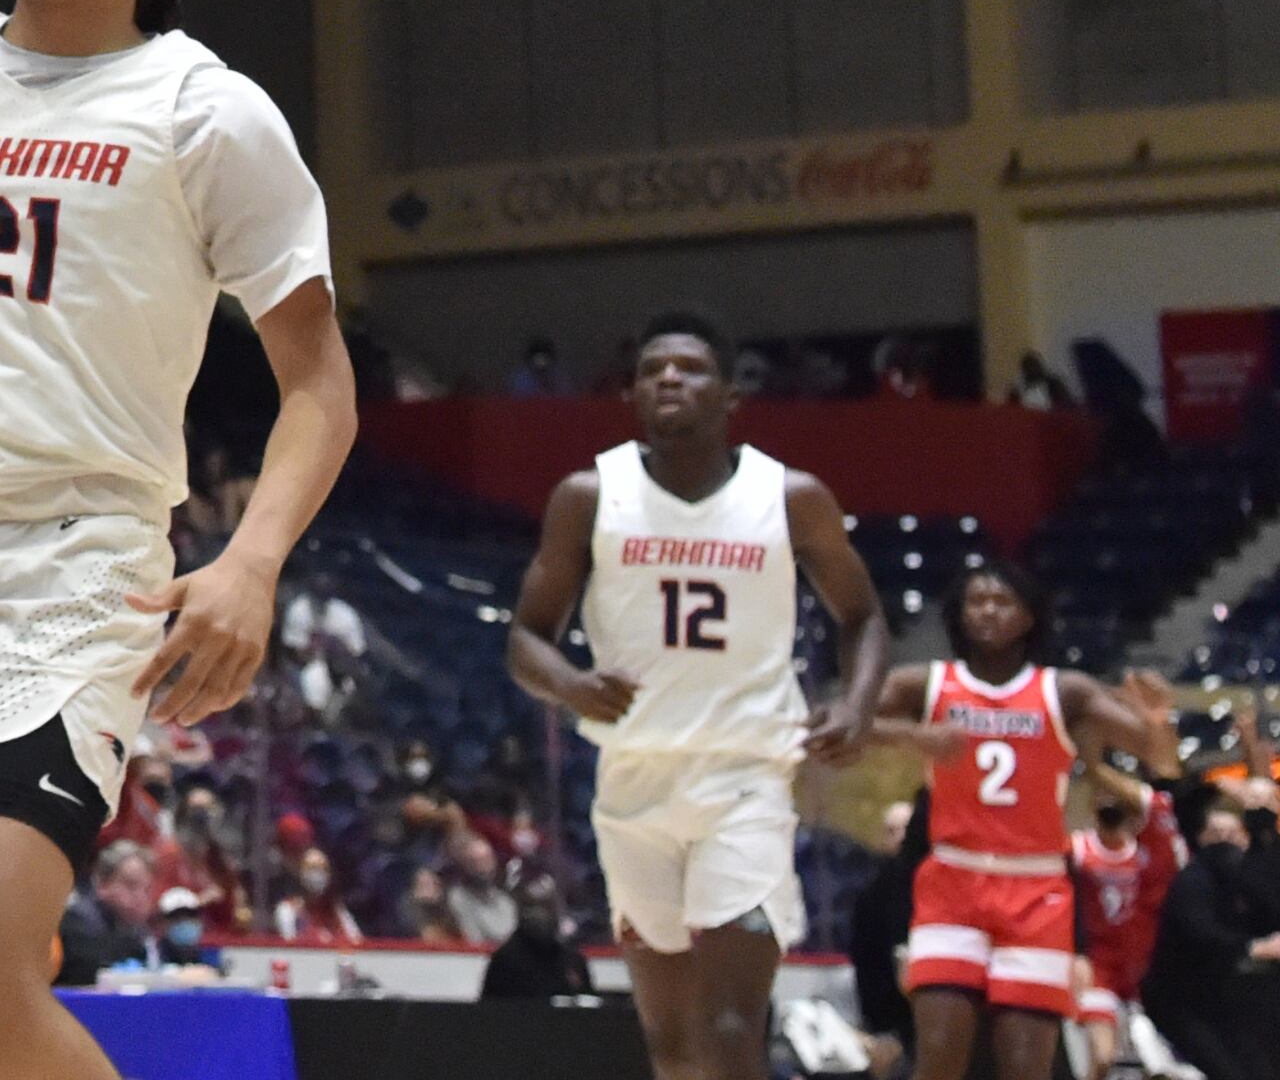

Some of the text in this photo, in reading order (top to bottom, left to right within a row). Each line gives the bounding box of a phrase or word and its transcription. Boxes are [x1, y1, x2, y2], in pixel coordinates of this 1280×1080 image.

[498, 150, 790, 223] CONCESSIONS
[622, 536, 767, 573] BERKMAR
[659, 576, 727, 651] 12
[975, 739, 1019, 806] 2
